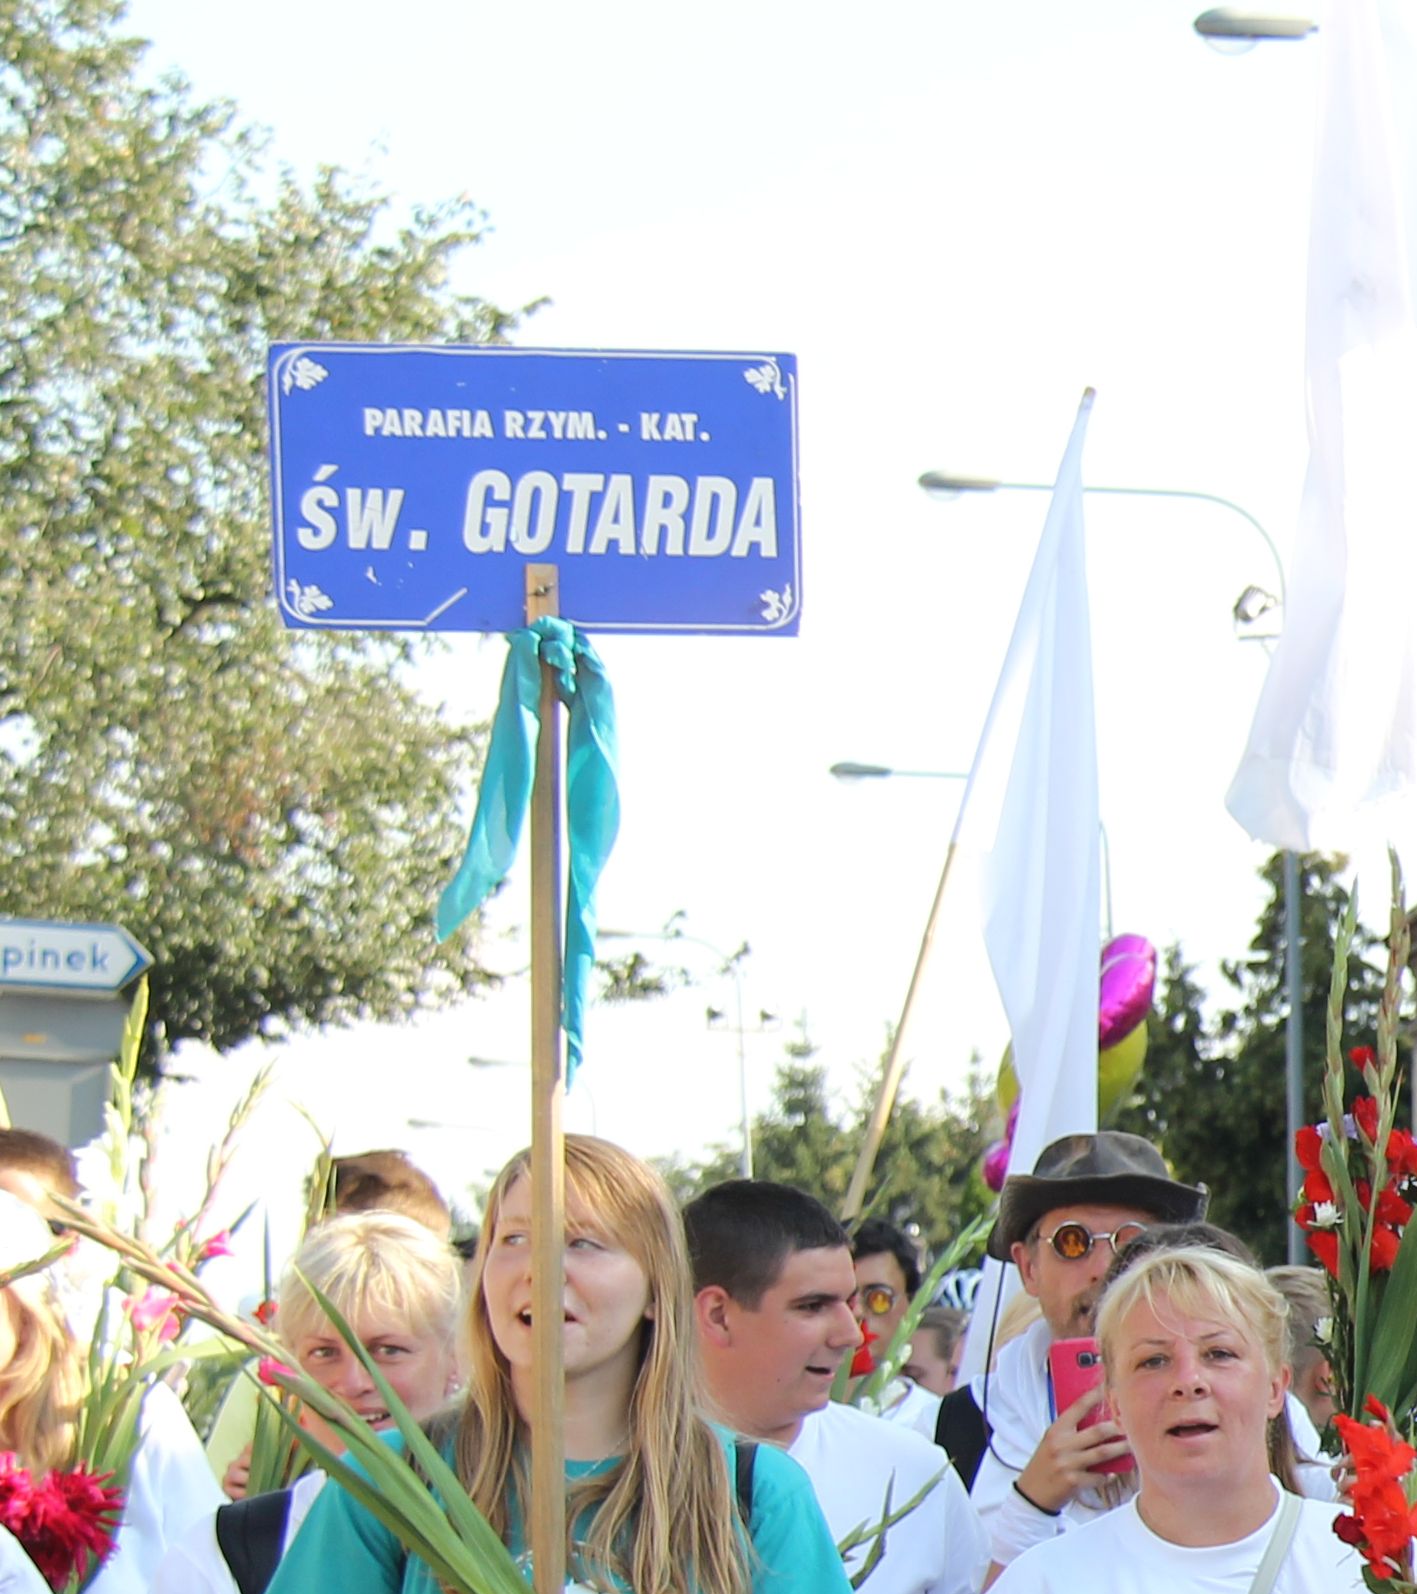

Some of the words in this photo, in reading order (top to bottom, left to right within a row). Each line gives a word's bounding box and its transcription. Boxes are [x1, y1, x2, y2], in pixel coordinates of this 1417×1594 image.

[363, 407, 495, 439] PARAFIA
[504, 411, 608, 441] RZYM.
[640, 413, 711, 442] KAT.
[297, 464, 429, 551] ŚW.
[462, 469, 779, 558] GOTARDA
